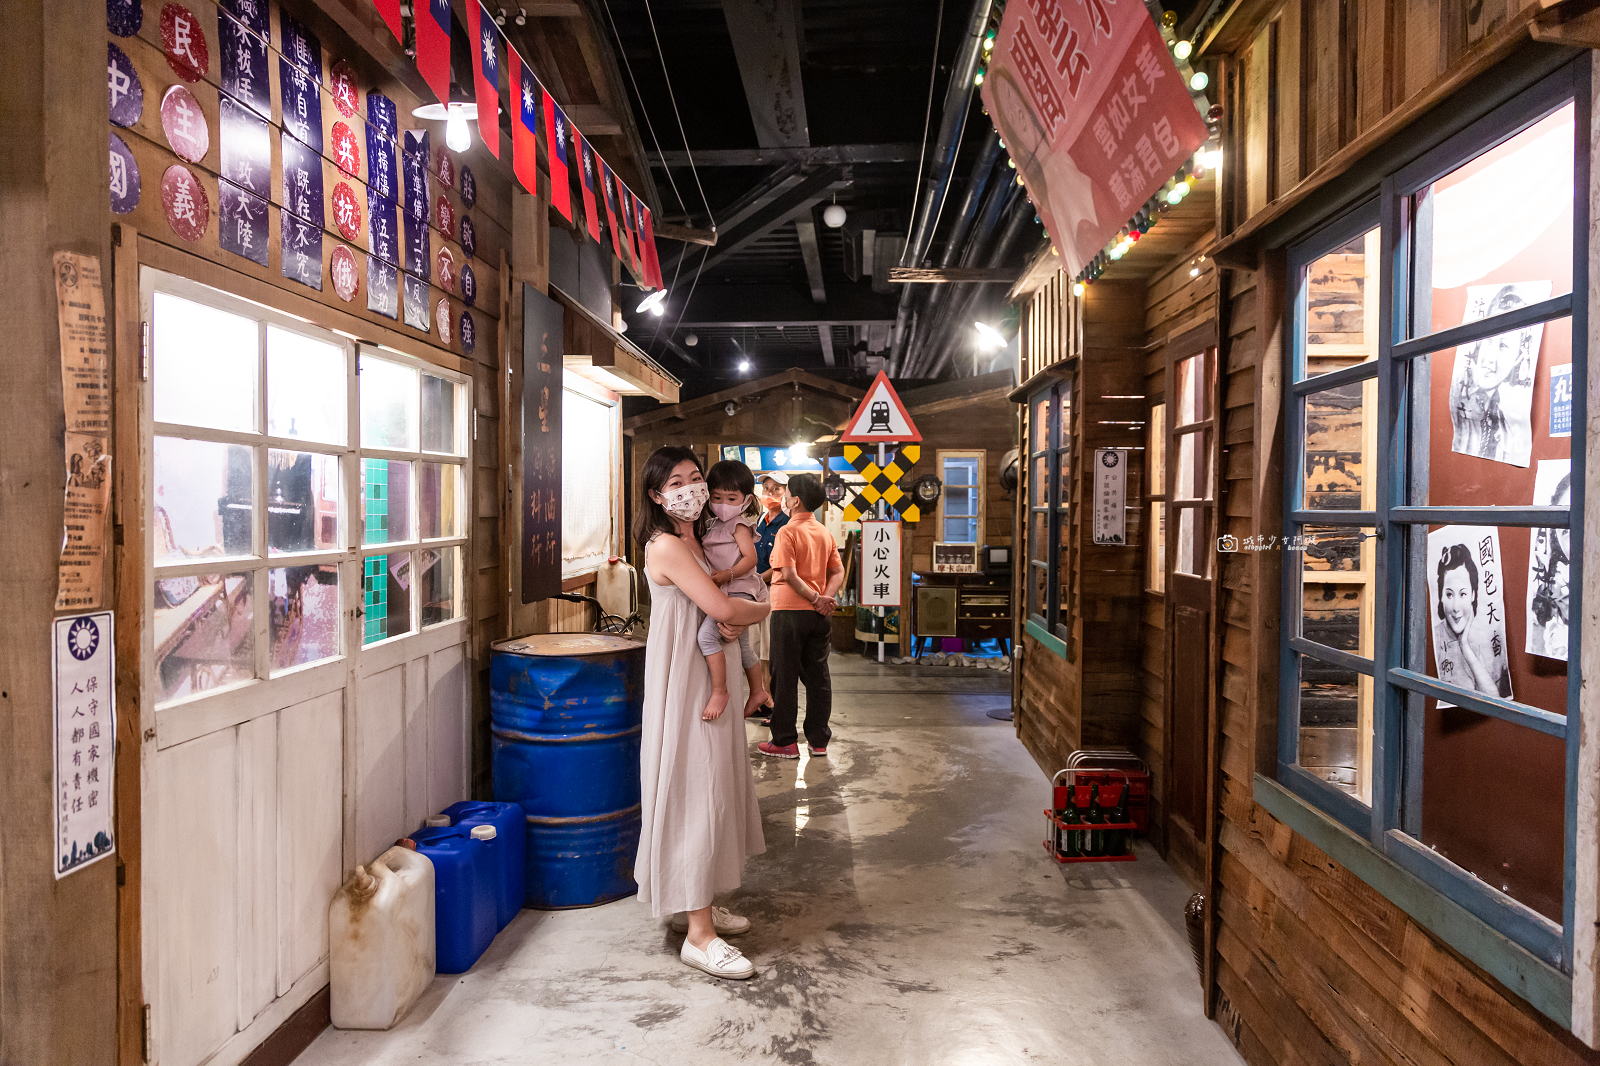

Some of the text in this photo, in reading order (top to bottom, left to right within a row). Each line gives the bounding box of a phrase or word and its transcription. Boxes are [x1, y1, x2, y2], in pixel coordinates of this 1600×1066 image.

[1092, 42, 1165, 159] 美女如雲
[1109, 115, 1180, 211] 包君滿意
[337, 73, 355, 287] 反共抗俄
[462, 172, 473, 344] 莊敬自強
[873, 528, 890, 599] 小心火車
[1479, 536, 1501, 657] 國色天香
[71, 682, 85, 813] 人人都有責任
[86, 675, 100, 808] 保守國家機密
